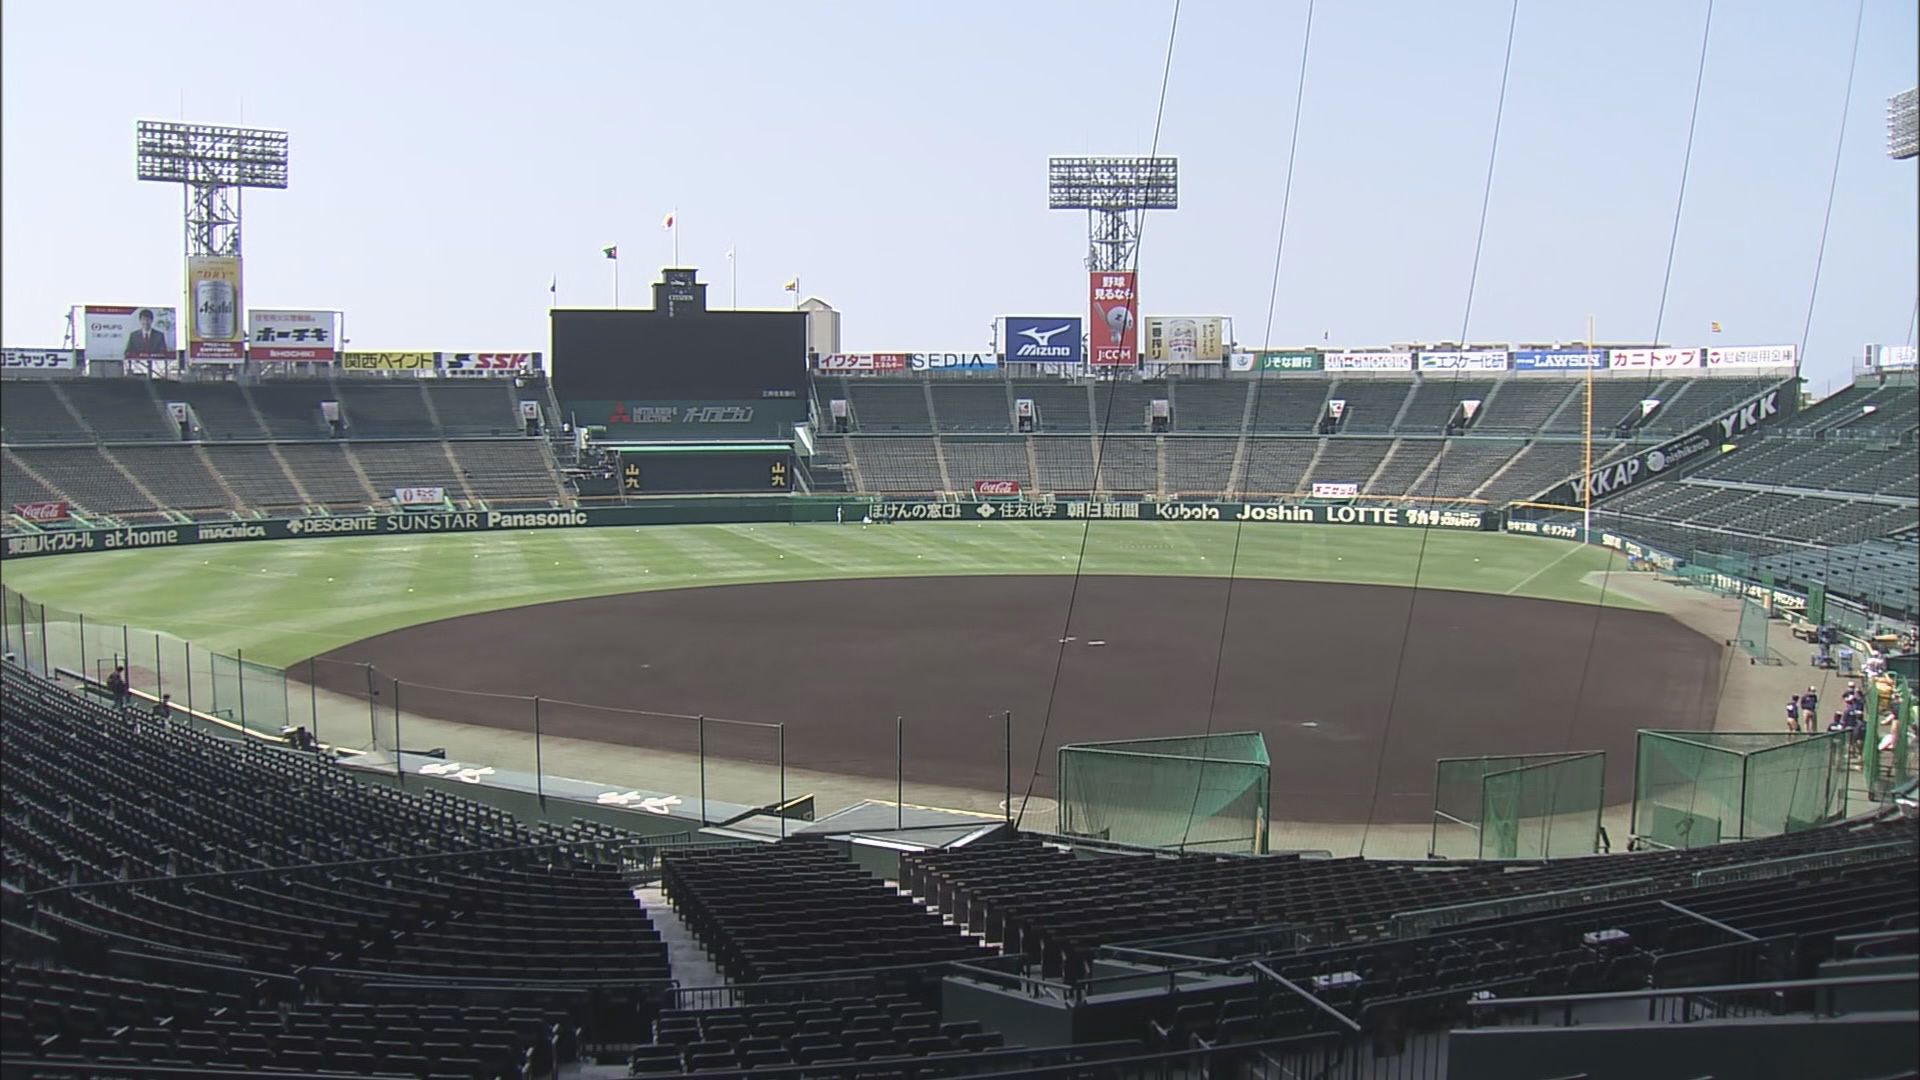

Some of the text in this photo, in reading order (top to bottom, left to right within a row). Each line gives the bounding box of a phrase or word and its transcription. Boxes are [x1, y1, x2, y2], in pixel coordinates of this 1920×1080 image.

[1102, 276, 1126, 288] 野球
[1094, 288, 1134, 301] 見るなら
[199, 301, 232, 314] Asahi
[256, 327, 329, 342] ホーチキ
[344, 353, 432, 369] 関西ペイント
[475, 353, 529, 369] SSK
[821, 354, 872, 367] イワタニ
[1097, 349, 1131, 362] J:COM
[1263, 356, 1313, 369] りそな銀行
[1436, 354, 1505, 369] エスケー化研
[1533, 354, 1600, 367] LAWSON
[1613, 350, 1697, 367] カニトップ
[1719, 391, 1777, 438] YKK
[625, 464, 641, 489] 山九
[771, 462, 786, 487] 山九
[1612, 459, 1640, 490] AP
[488, 509, 587, 528] Panasonic
[998, 503, 1057, 518] 住友化学
[1067, 503, 1139, 518] 朝日新聞
[1156, 502, 1220, 520] Kubota
[1236, 503, 1313, 521] Joshin
[1327, 505, 1398, 524] LOTTE
[304, 516, 377, 533] DESCENTE
[387, 513, 479, 532] SUNSTAR
[128, 528, 178, 546] home
